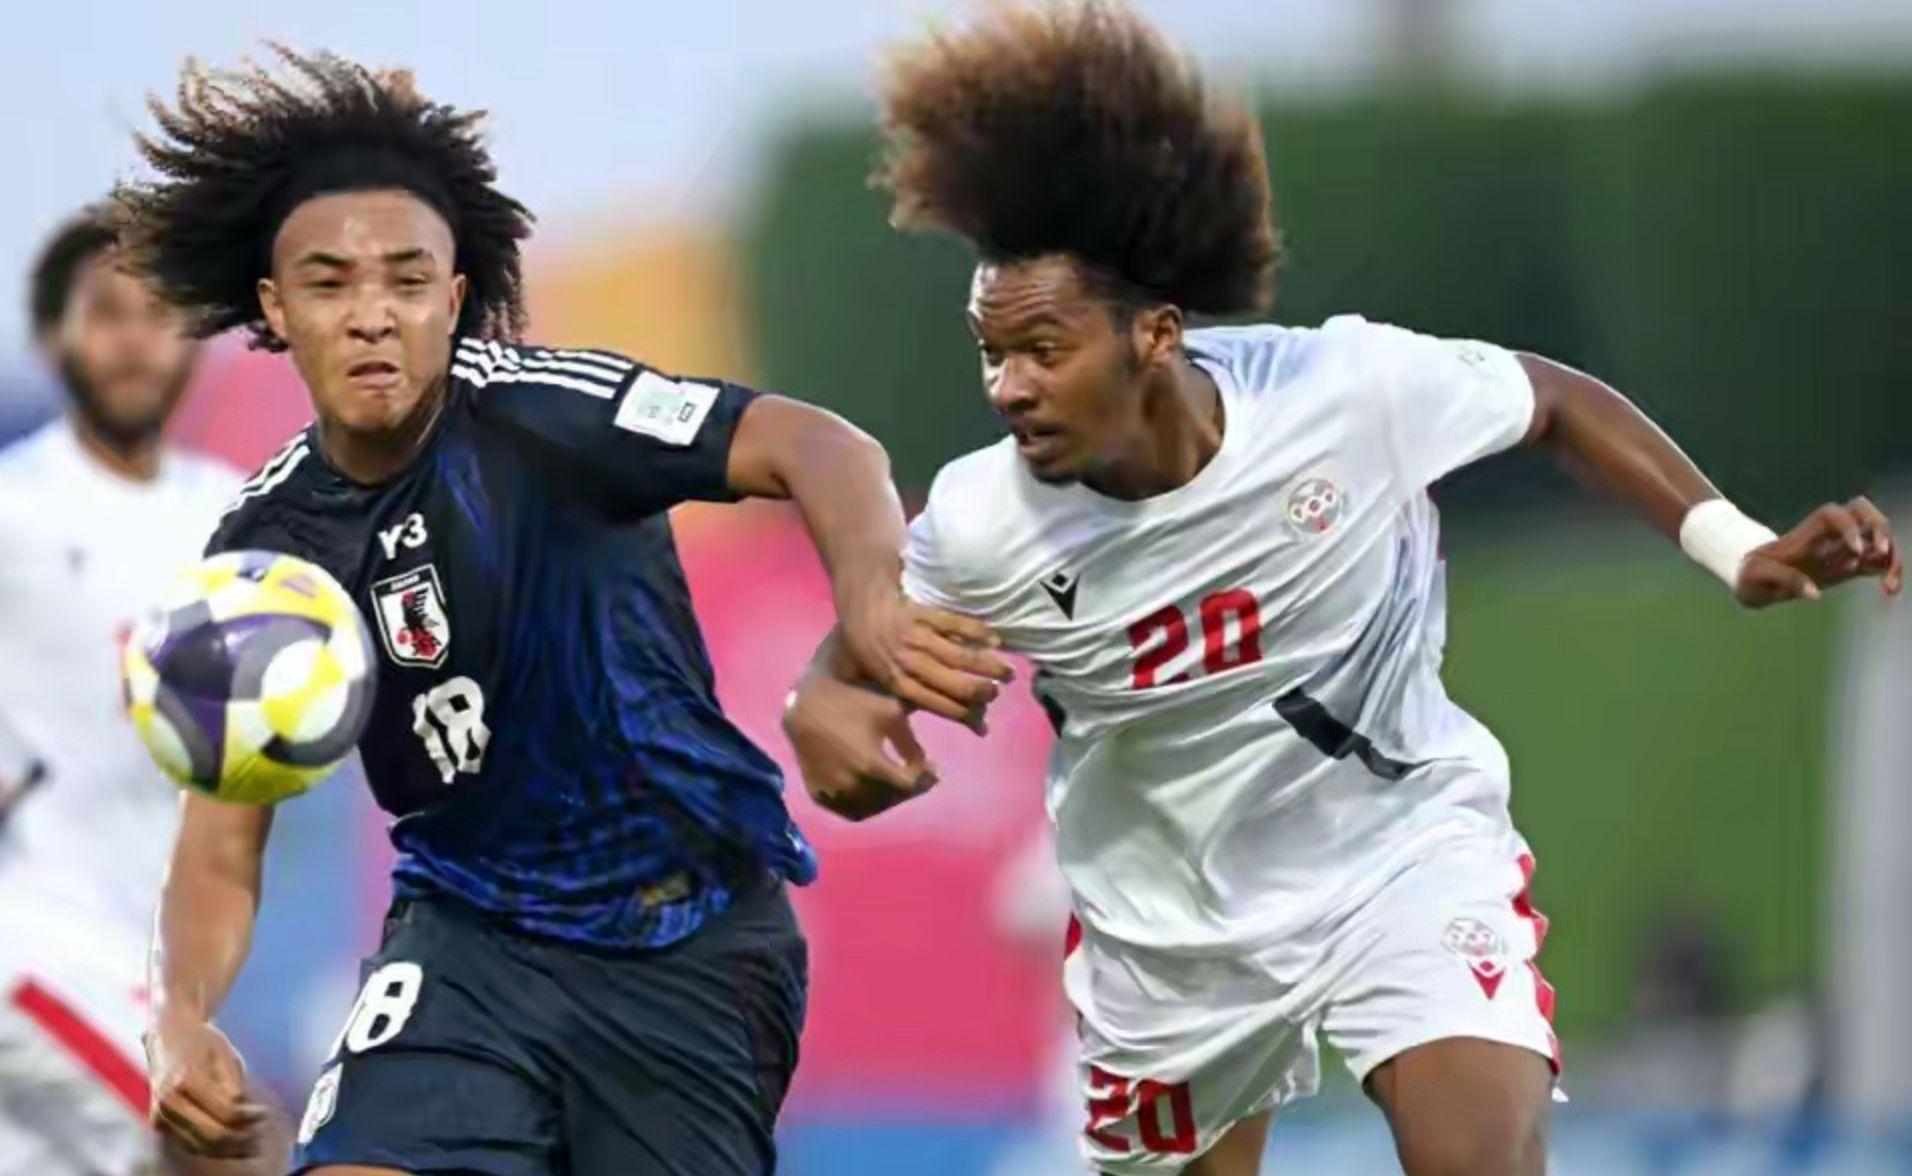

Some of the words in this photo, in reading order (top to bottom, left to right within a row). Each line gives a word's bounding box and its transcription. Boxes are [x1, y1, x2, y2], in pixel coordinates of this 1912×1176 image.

[378, 512, 428, 560] Y3
[1127, 587, 1264, 691] 20
[412, 675, 493, 785] 18
[1084, 1064, 1197, 1154] 20
